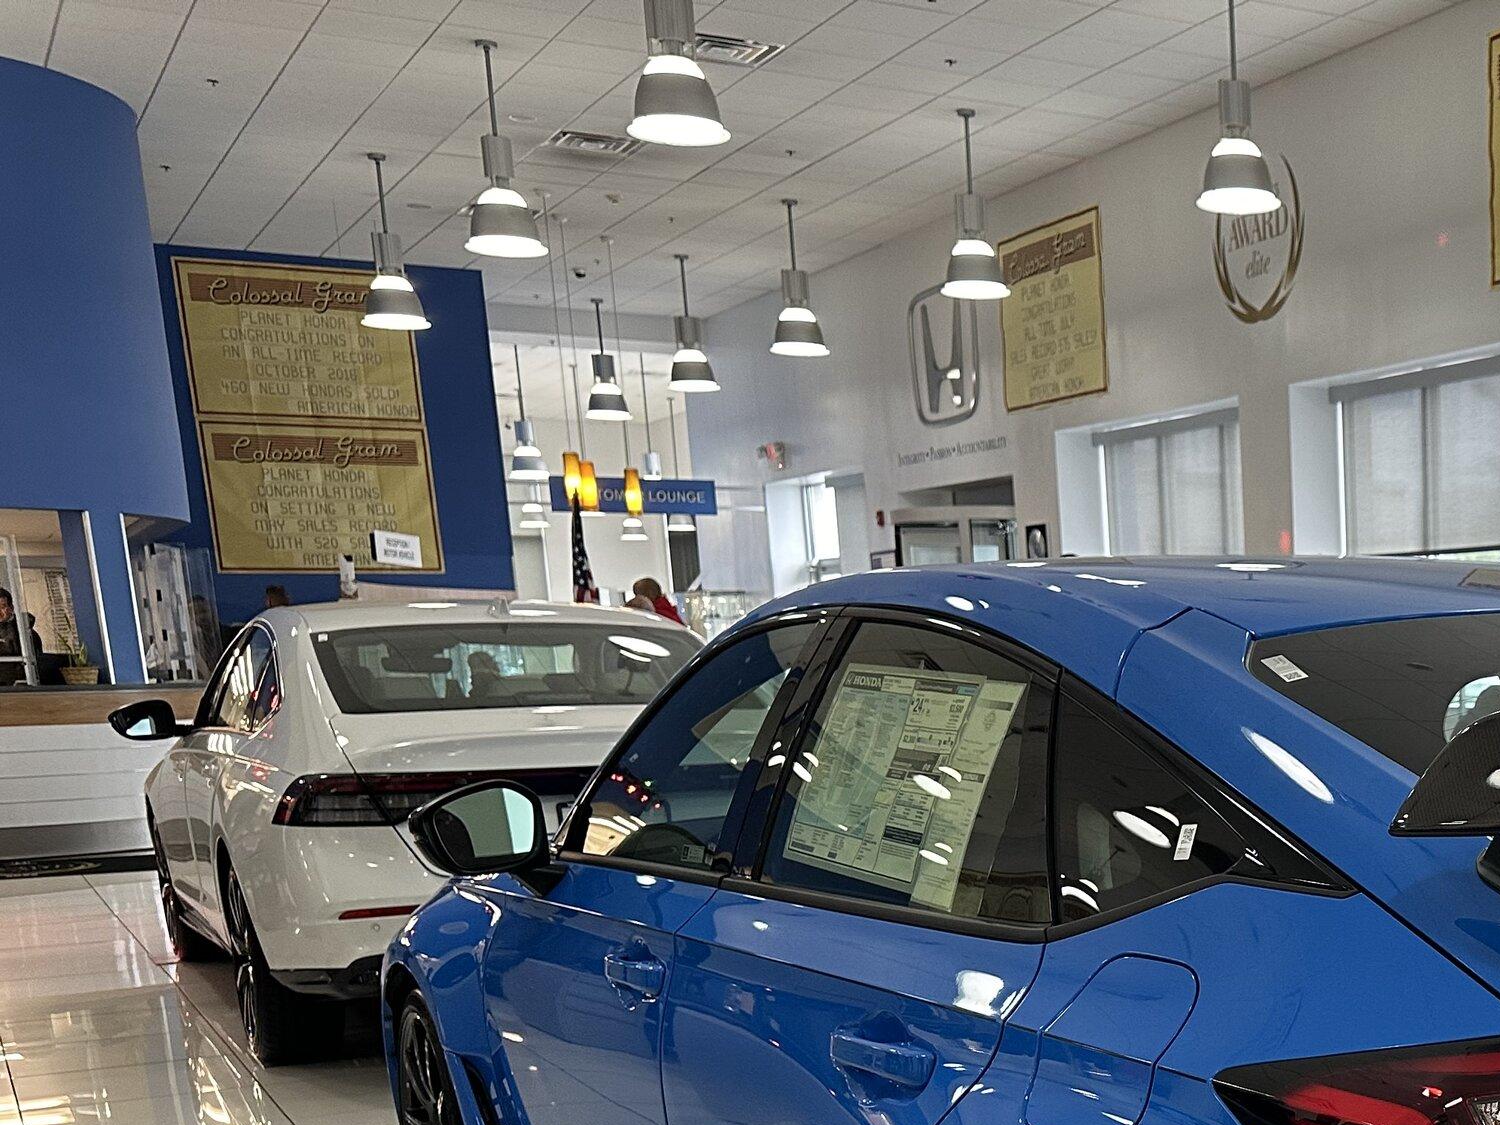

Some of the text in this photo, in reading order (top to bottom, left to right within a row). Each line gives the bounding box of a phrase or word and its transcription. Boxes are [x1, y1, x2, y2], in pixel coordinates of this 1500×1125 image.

[207, 278, 304, 305] Colossal
[240, 310, 346, 328] PLANET HONDA
[221, 328, 375, 348] CONGRATULATIONS ON
[223, 345, 382, 366] AN ALL TIME RECORD
[256, 363, 316, 380] OCTOBER
[259, 382, 290, 395] NEW
[303, 384, 353, 397] HONDAS
[297, 400, 417, 416] AMERICAN HONDA
[231, 435, 402, 469] Colossal Gram
[262, 467, 366, 482] PLANET HONDA
[257, 484, 381, 500] CONGRATULATIONS
[648, 489, 705, 504] LOUNGE
[251, 502, 396, 516] ON SETTING A NEW
[255, 518, 398, 533] MAY SALES RECORD
[266, 536, 302, 549] WITH
[313, 536, 339, 550] 520
[303, 552, 371, 566] AMERAN
[853, 676, 881, 688] HONDA
